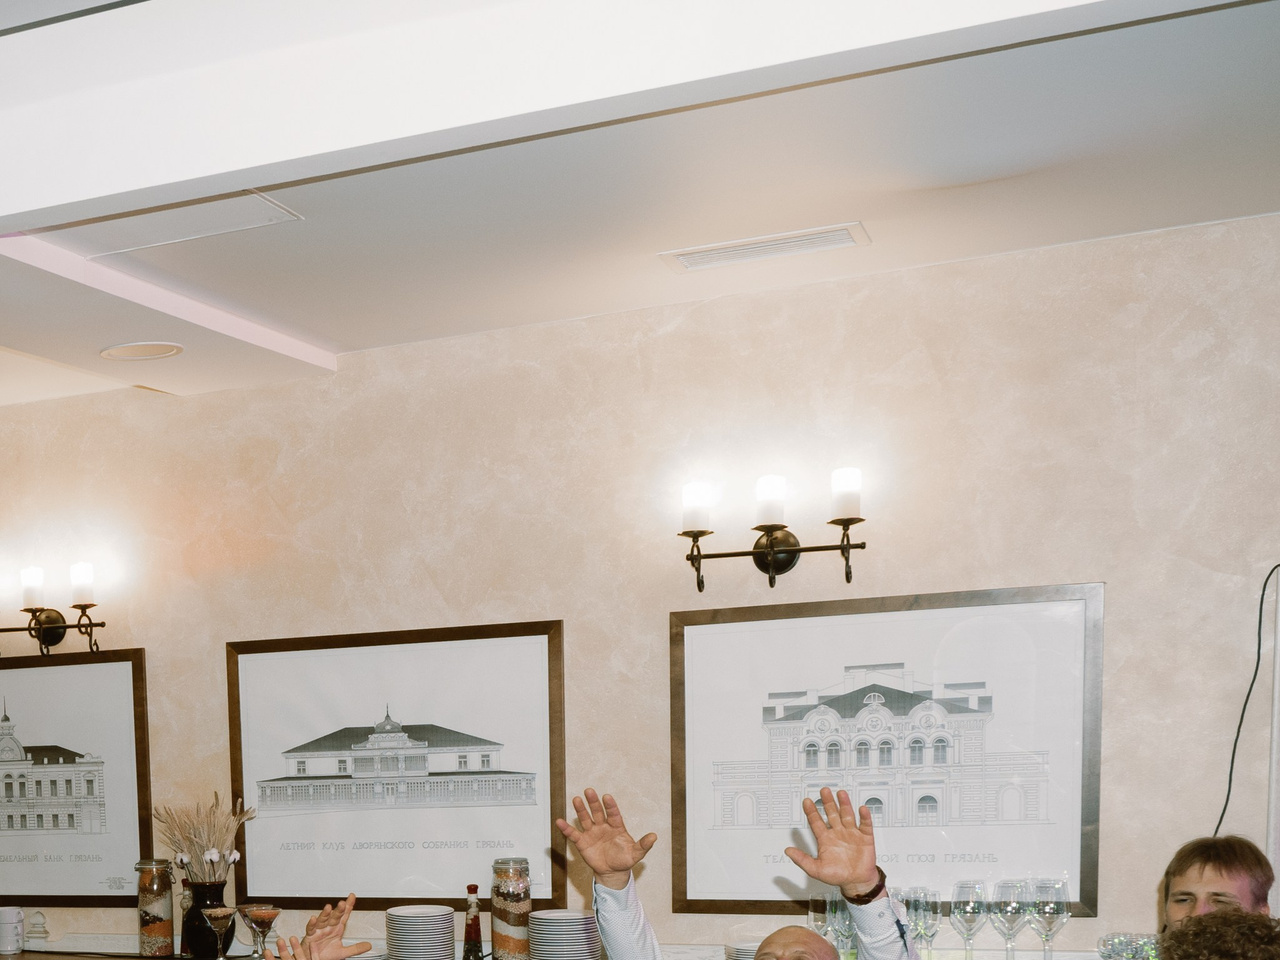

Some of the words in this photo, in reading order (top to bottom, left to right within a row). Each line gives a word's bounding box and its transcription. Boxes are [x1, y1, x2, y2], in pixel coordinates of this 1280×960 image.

[280, 841, 315, 850] ЛЕТНИЙ
[322, 842, 345, 850] КЛУБ
[352, 841, 415, 850] ДВОРЯНСКОГО
[422, 840, 469, 849] СОБРАНИЯ
